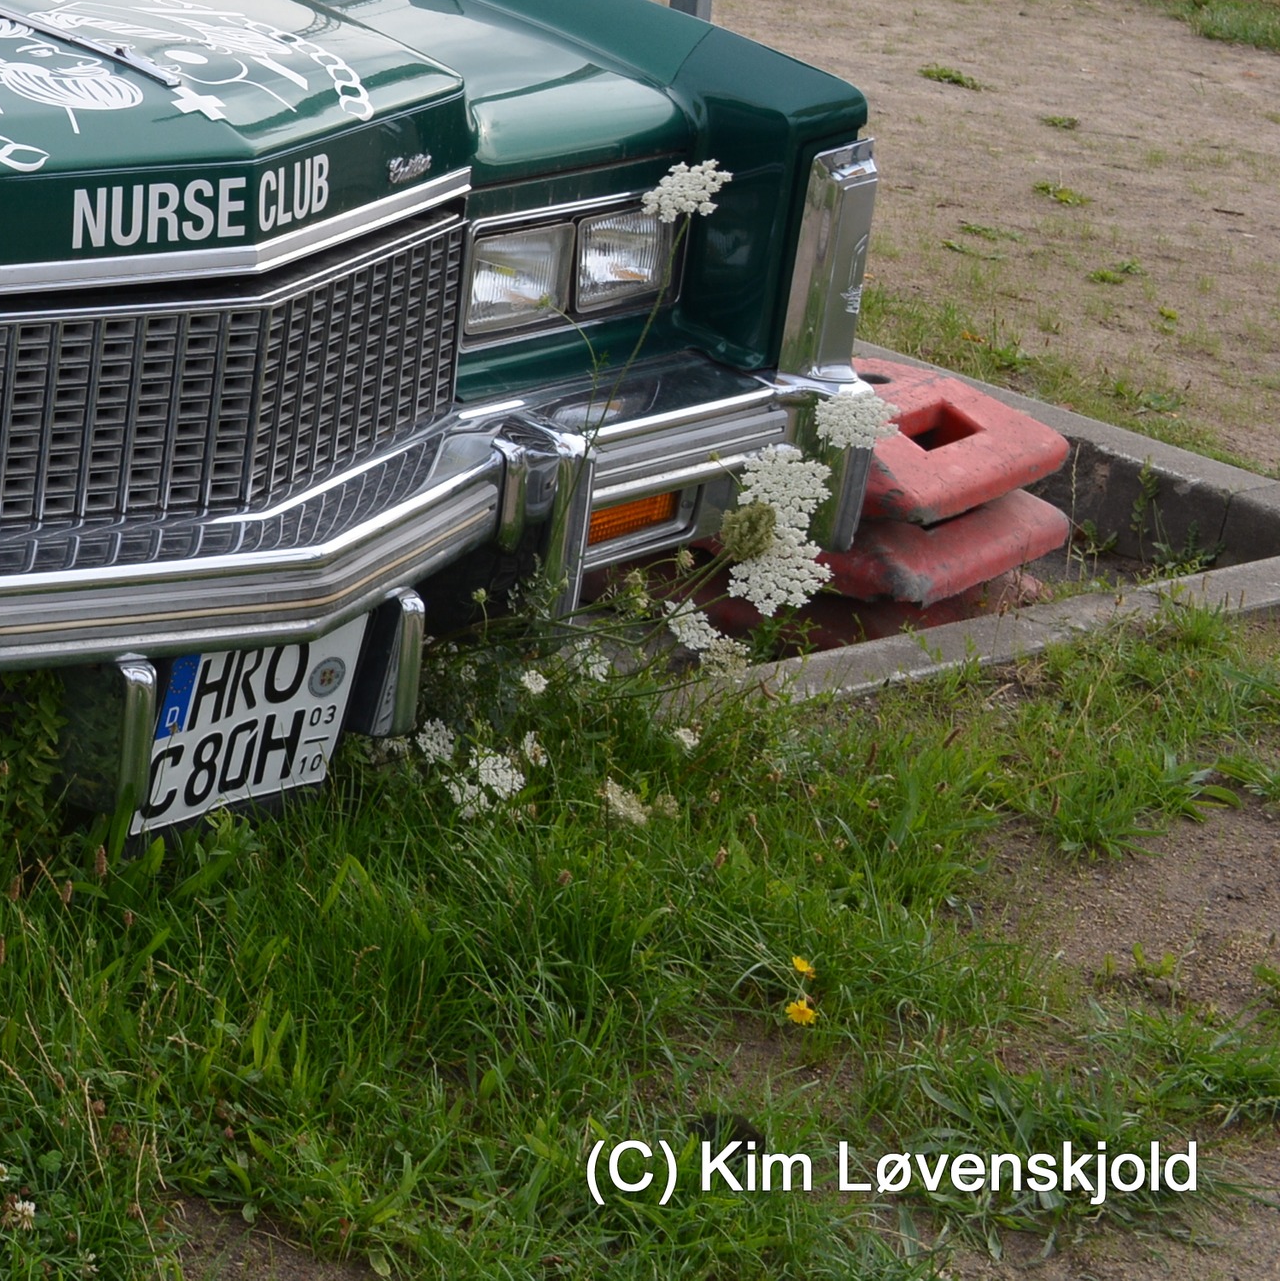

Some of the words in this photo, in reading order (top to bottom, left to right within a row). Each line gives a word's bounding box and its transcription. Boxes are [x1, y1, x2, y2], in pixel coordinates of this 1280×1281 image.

[71, 176, 246, 250] NURSE
[258, 153, 330, 232] CLUB
[187, 643, 310, 732] HRO
[165, 706, 180, 728] D
[309, 705, 337, 727] 03
[299, 753, 323, 775] 10
